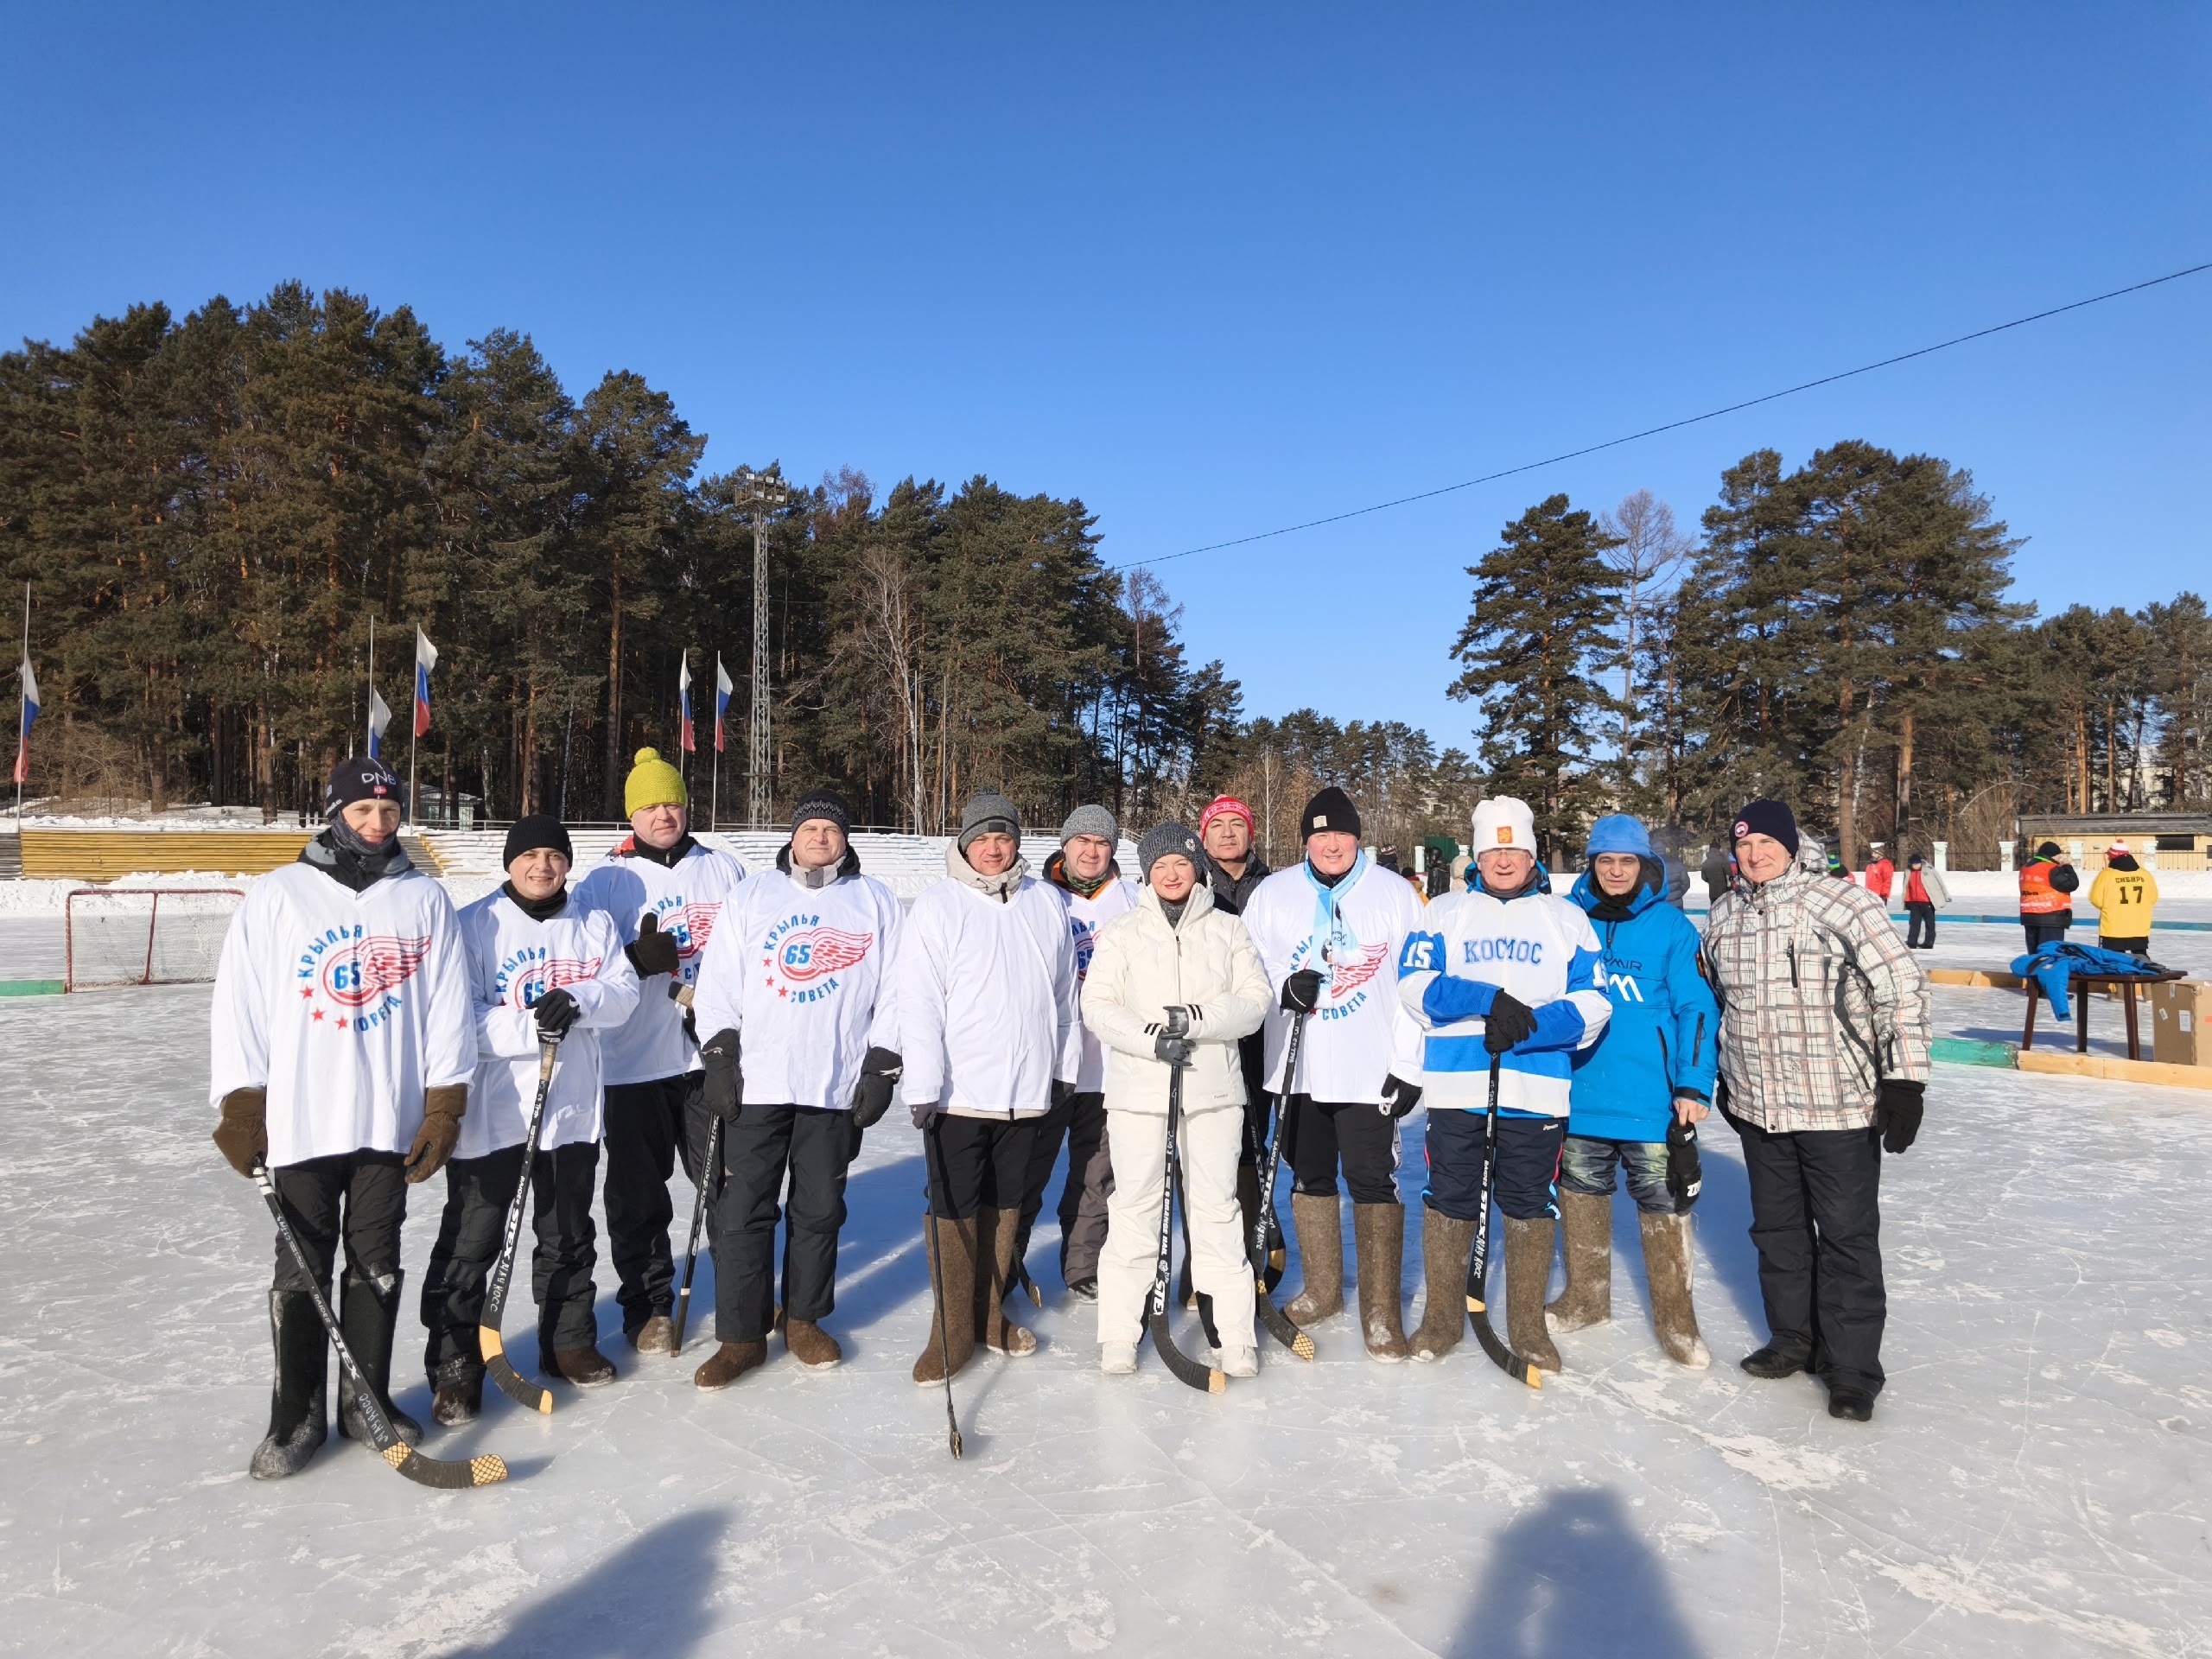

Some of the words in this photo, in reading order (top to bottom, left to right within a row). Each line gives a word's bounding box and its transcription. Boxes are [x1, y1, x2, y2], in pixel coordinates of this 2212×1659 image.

[361, 772, 397, 785] DNB
[2120, 886, 2143, 905] 17
[764, 913, 820, 951] КРЫЛЬЯ
[296, 924, 363, 978] КРЫЛЬЯ
[785, 944, 811, 965] 65
[1402, 940, 1434, 969] 15
[1463, 936, 1543, 966] КОСМОС
[334, 961, 362, 990] 65
[494, 946, 546, 993] КРЫЛЬЯ
[1592, 957, 1608, 993] 1
[791, 976, 840, 1003] СОВЕТА
[1322, 991, 1367, 1021] СОВЕТА
[1270, 1140, 1279, 1166] RAIDER
[516, 1175, 525, 1205] RAIDER
[1260, 1168, 1274, 1217] STEX
[1478, 1189, 1488, 1239] STEX
[504, 1207, 519, 1261] STEX
[314, 1294, 331, 1324] RAIDER
[329, 1326, 361, 1381] STEX
